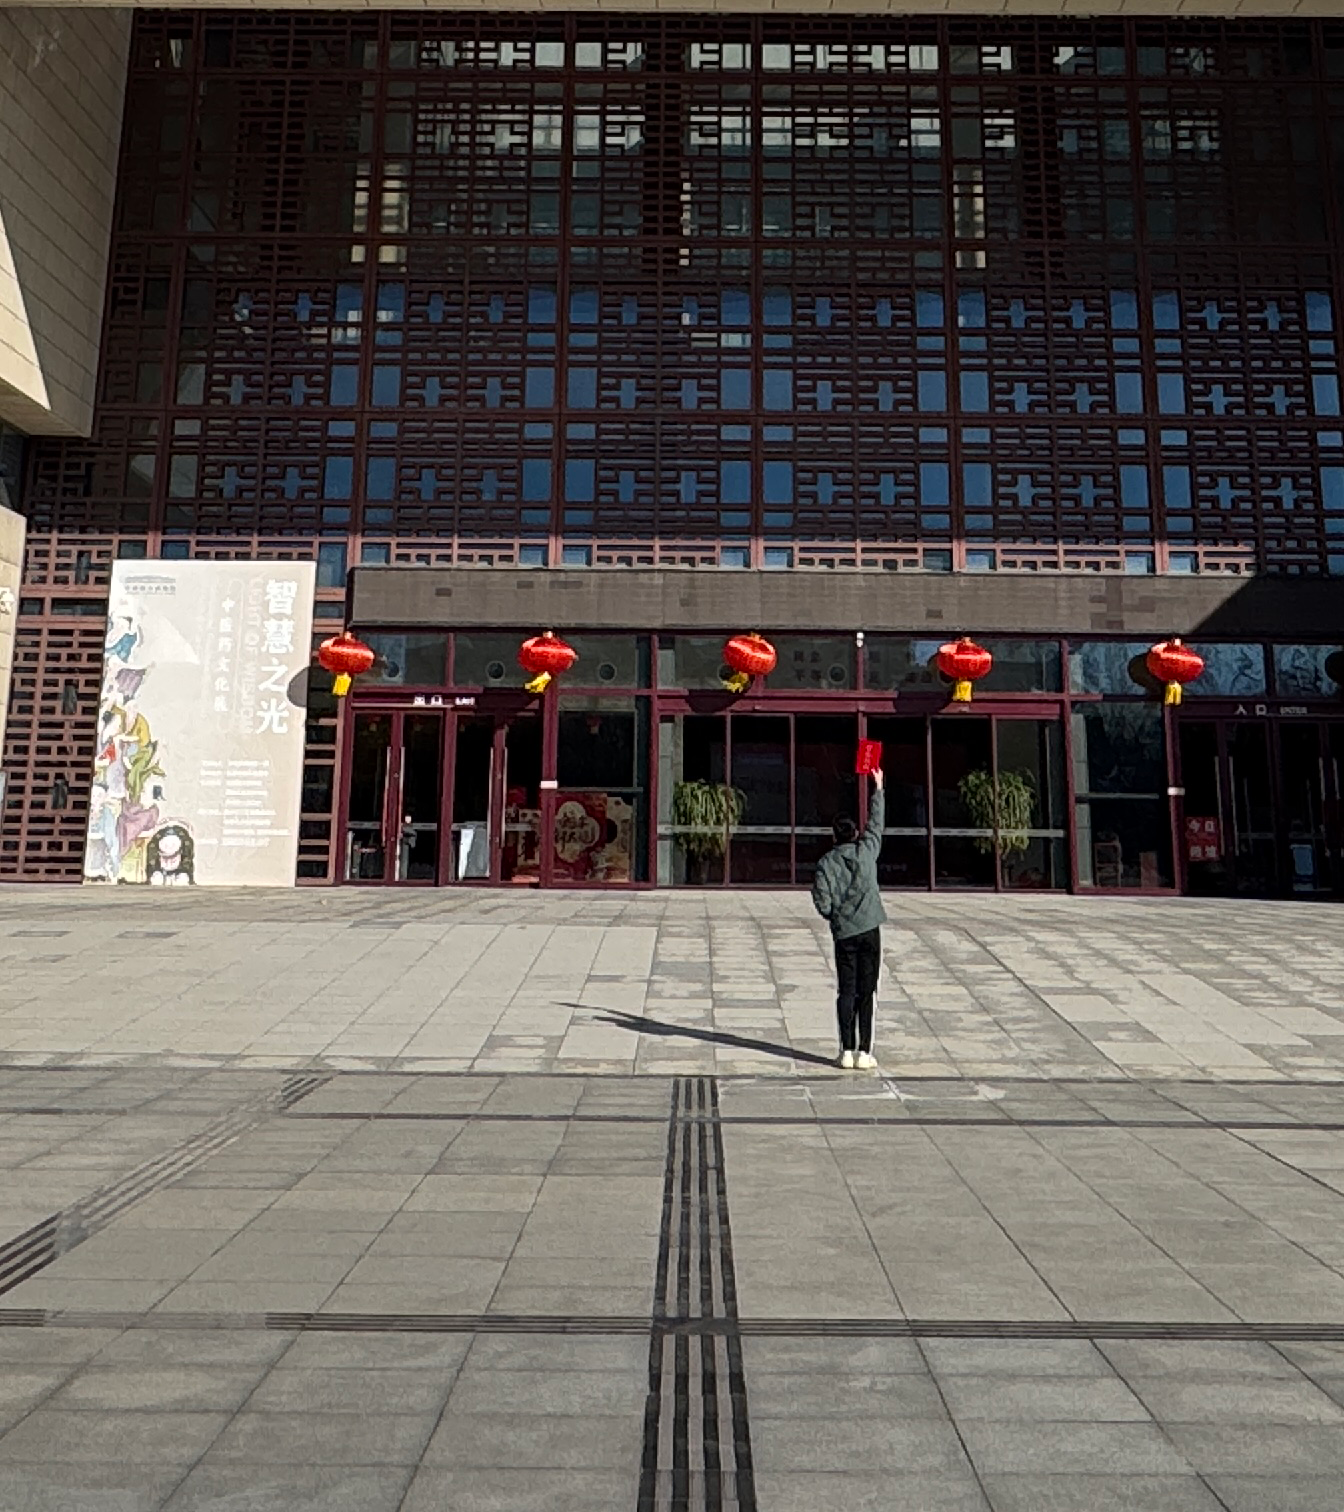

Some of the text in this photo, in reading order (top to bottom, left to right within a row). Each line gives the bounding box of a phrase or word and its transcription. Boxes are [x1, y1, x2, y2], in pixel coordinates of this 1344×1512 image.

[254, 579, 298, 734] 智慧之光
[1234, 703, 1267, 716] 入口
